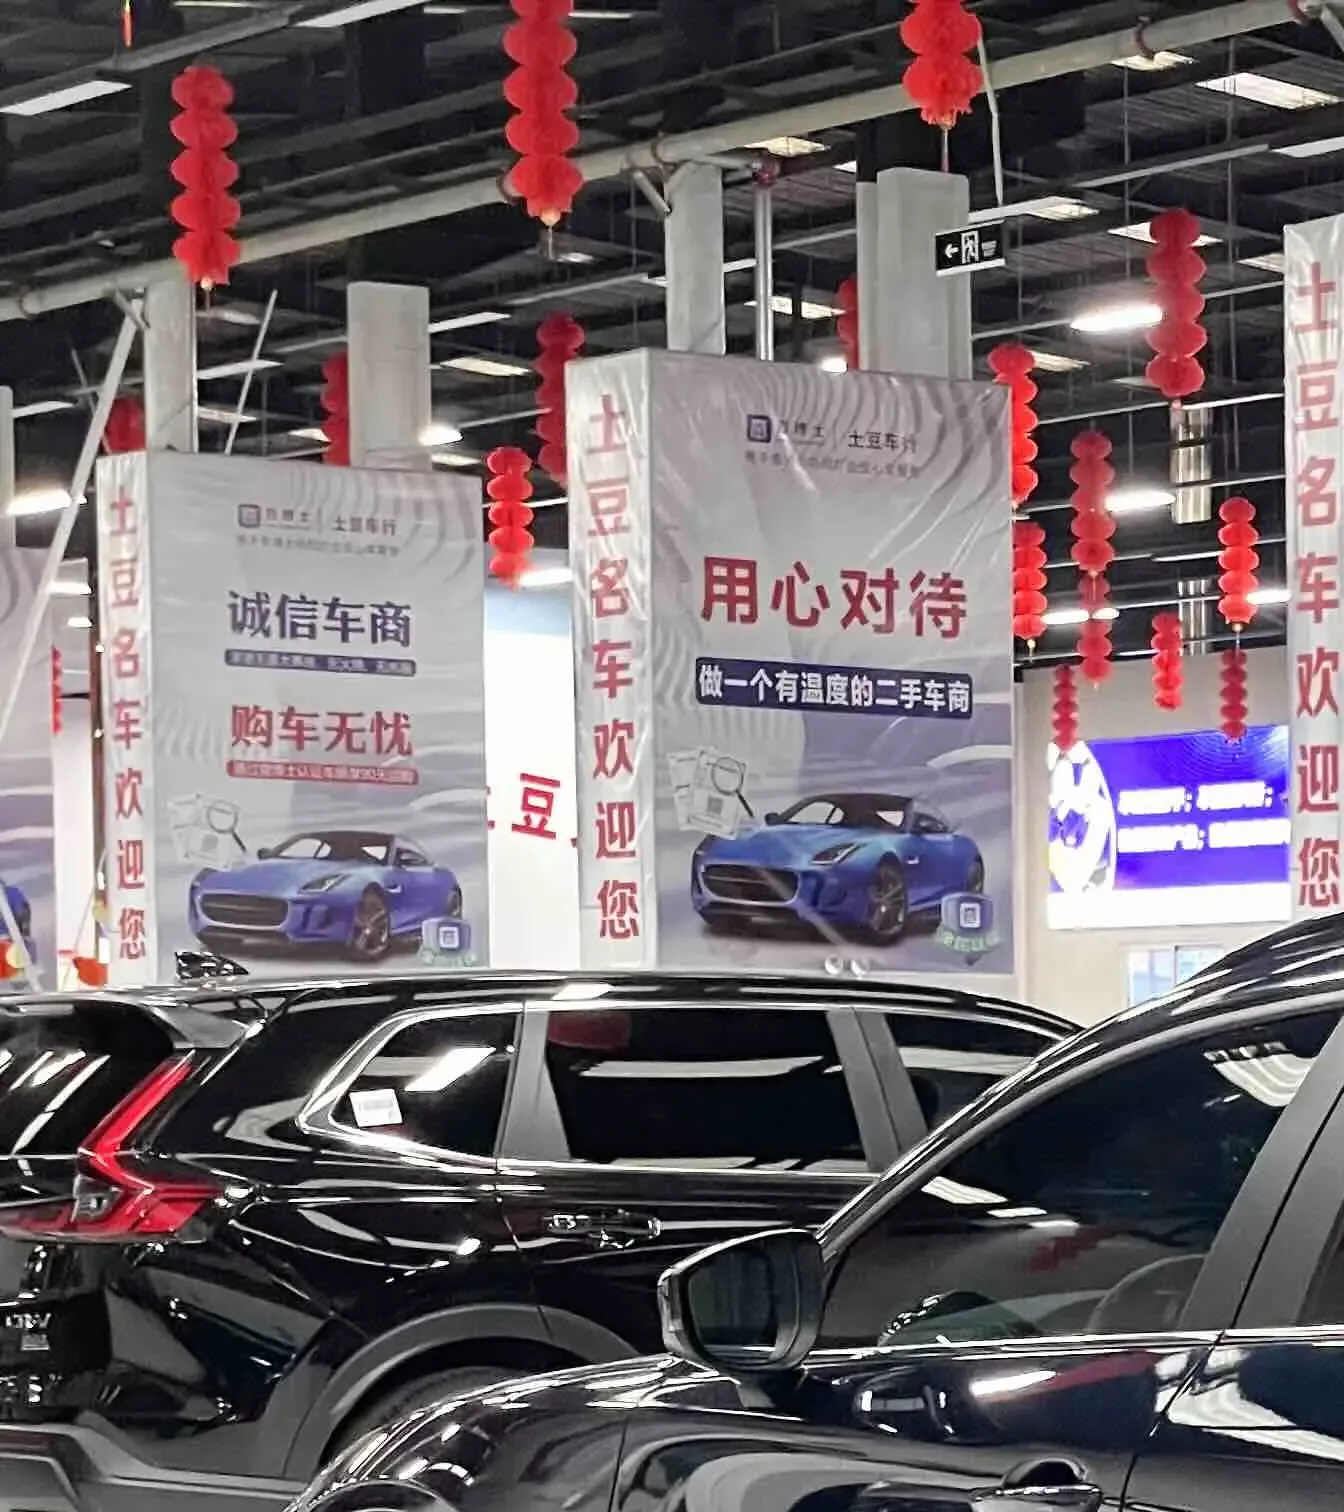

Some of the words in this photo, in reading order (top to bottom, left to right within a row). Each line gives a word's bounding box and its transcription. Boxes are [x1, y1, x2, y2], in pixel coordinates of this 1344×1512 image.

[226, 589, 412, 648] 诚信车商
[700, 555, 969, 640] 用心对待
[1293, 262, 1341, 909] 土豆名车欢迎您
[586, 394, 641, 940] 土豆名车欢迎您
[698, 661, 972, 716] 做一个有温度的二手车商
[109, 485, 148, 961] 土豆名车欢迎您
[231, 704, 414, 757] 购车无忧
